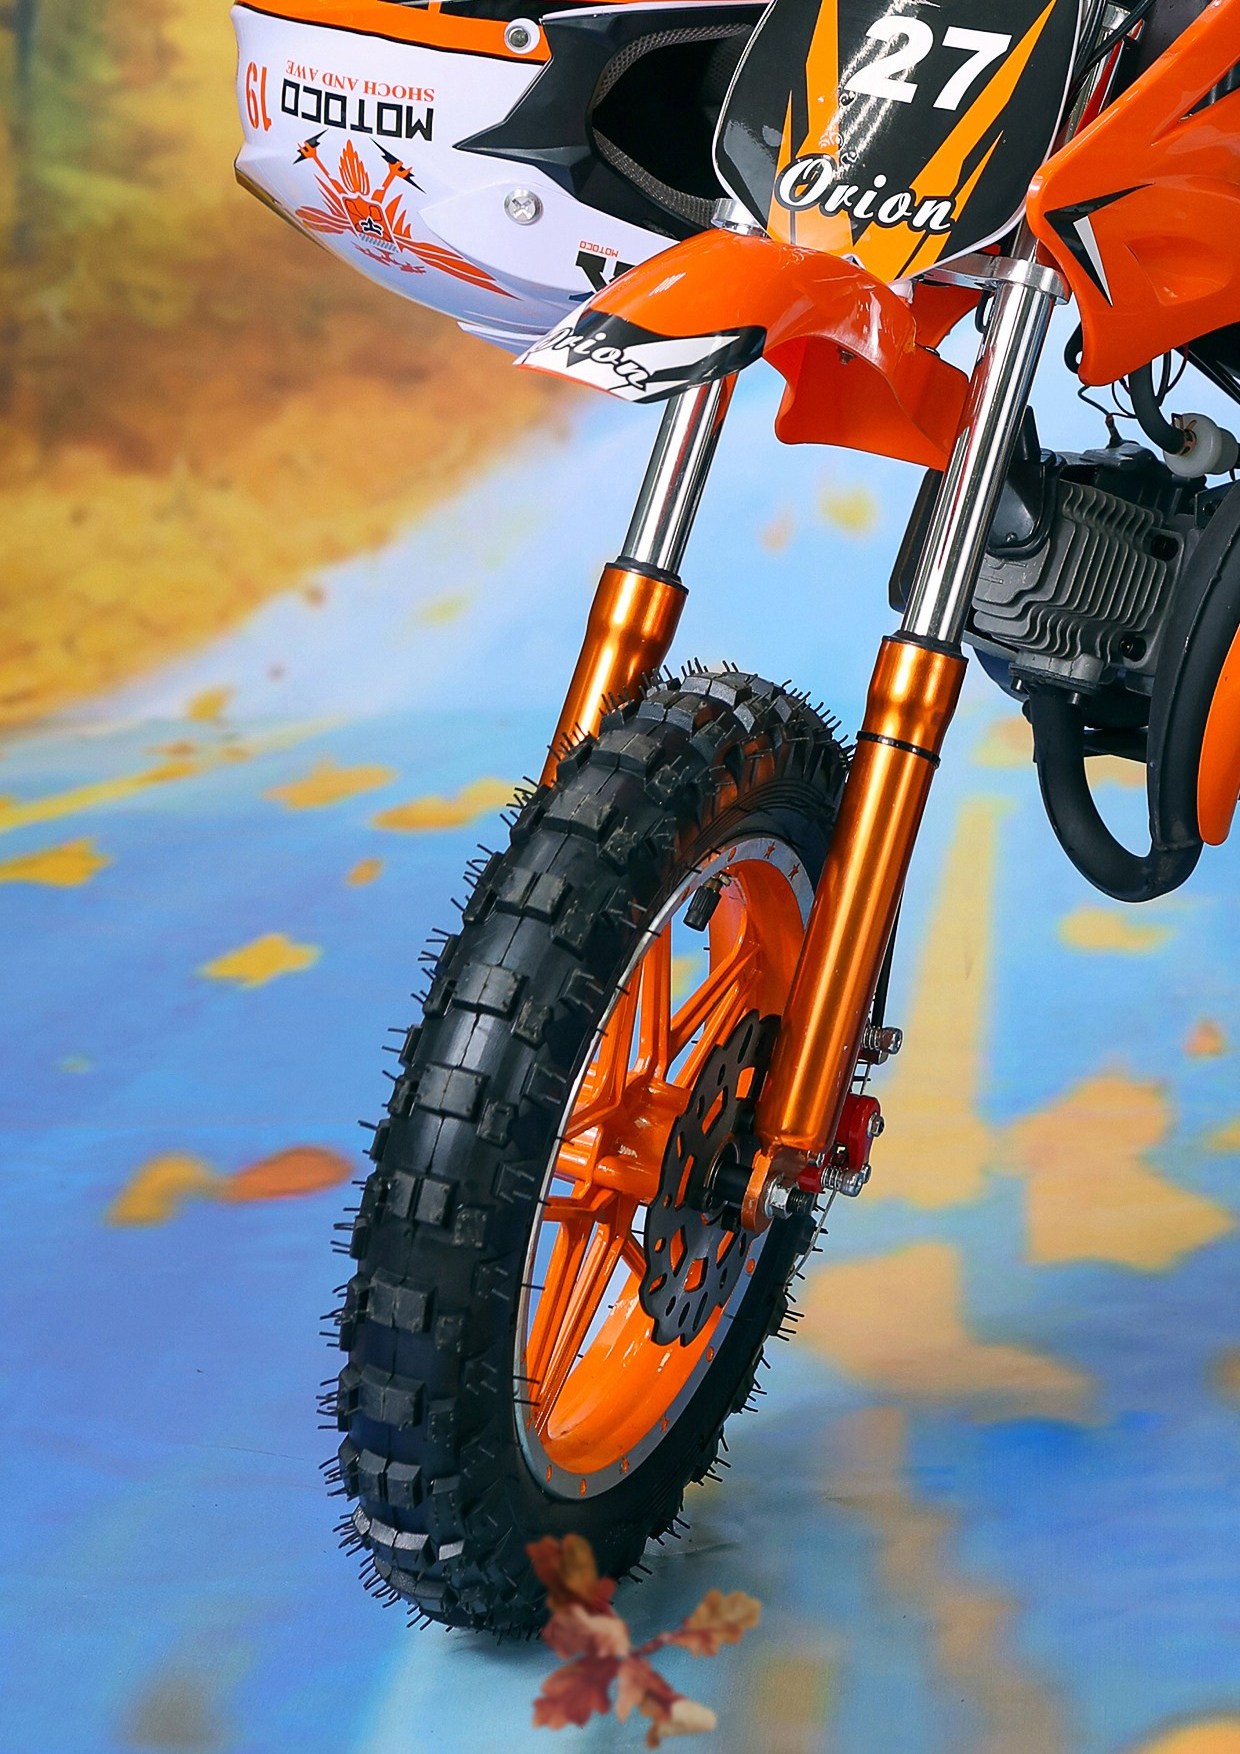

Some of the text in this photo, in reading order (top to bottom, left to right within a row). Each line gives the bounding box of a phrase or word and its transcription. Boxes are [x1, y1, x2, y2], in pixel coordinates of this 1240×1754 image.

[246, 62, 272, 131] 19
[286, 60, 435, 102] SHOCH AND AWE
[845, 16, 1011, 111] 27
[281, 78, 434, 141] MOTOCO
[776, 155, 954, 233] Orion
[579, 240, 619, 258] MOTOCO
